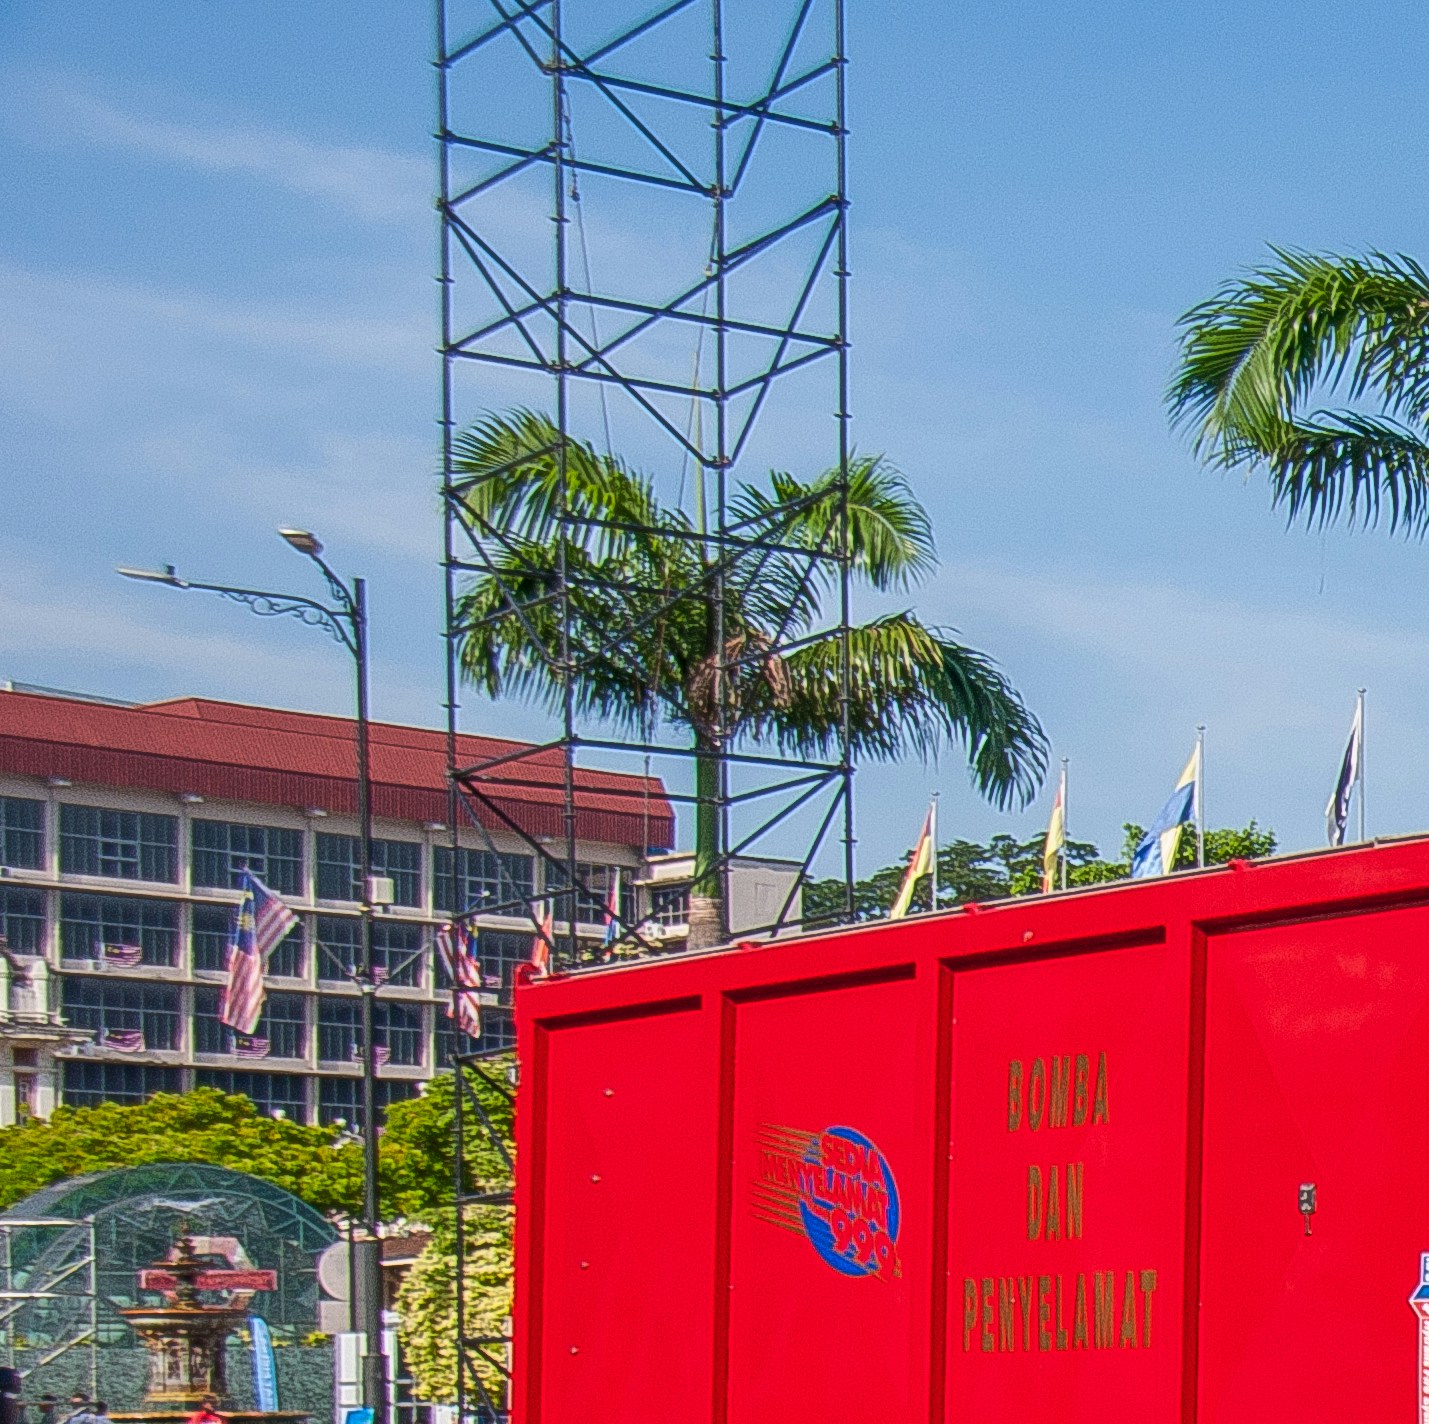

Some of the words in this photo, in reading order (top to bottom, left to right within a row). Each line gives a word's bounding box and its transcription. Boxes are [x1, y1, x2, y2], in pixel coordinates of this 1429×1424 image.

[1007, 1051, 1110, 1132] BOMBA
[1026, 1162, 1084, 1241] DAN
[962, 1269, 1157, 1353] PENYELAMAT
